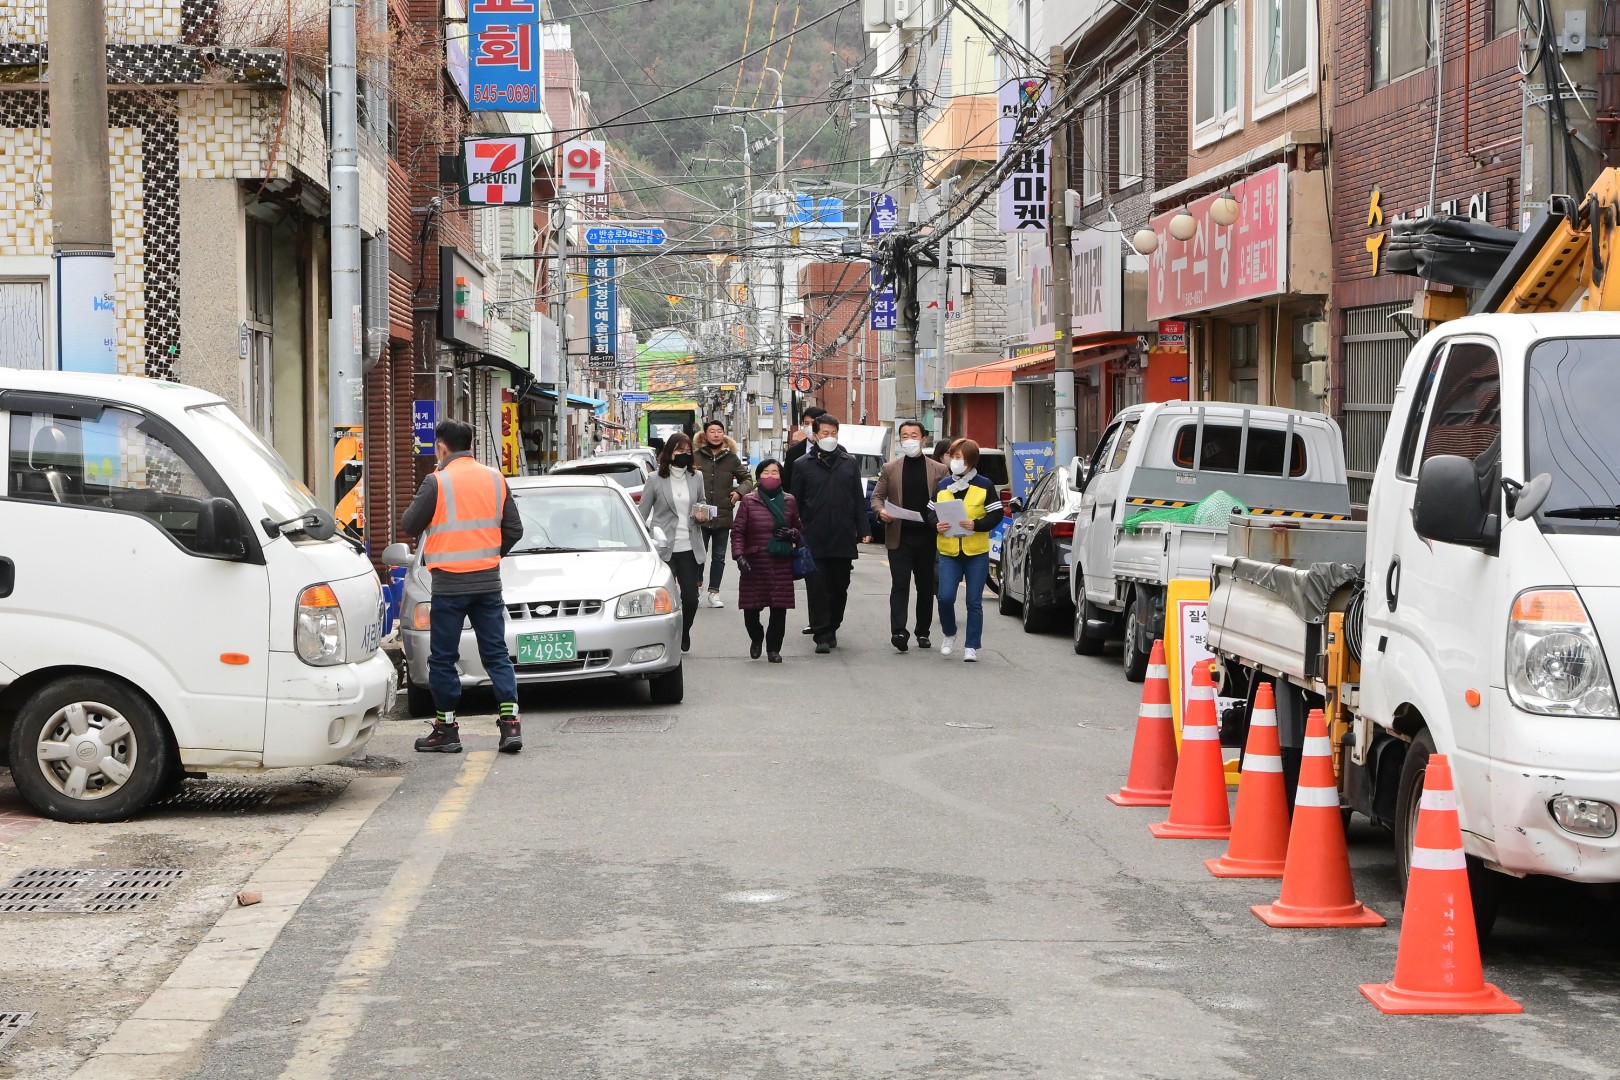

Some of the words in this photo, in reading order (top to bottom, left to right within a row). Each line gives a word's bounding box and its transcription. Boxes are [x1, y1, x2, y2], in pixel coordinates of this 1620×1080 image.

[473, 84, 537, 103] 545-0691
[567, 147, 601, 188] 약
[1240, 179, 1276, 235] 오리탕
[1239, 234, 1276, 286] 오리불고기
